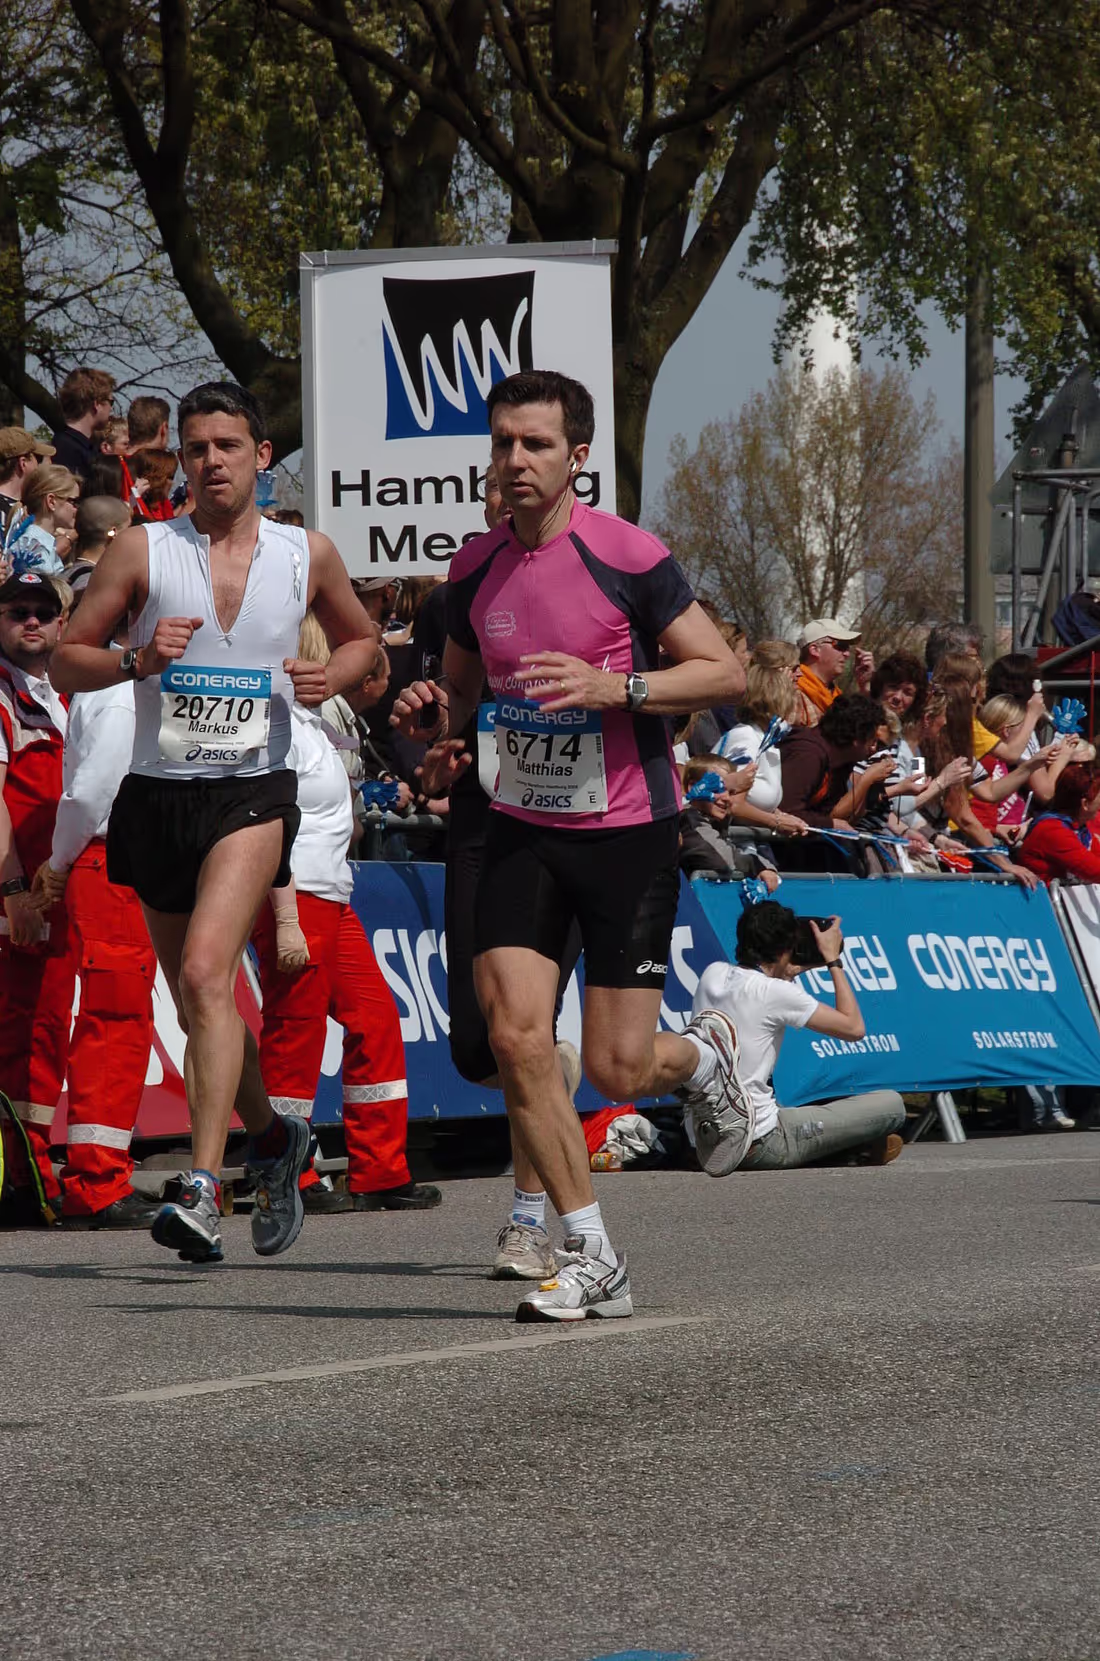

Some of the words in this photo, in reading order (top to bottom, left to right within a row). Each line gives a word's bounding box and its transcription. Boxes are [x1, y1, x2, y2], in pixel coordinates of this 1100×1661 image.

[331, 465, 601, 508] Hambg
[170, 672, 261, 690] CONERGY
[172, 694, 254, 722] 20710
[501, 704, 587, 725] CONERGY
[188, 720, 239, 735] Markus
[505, 729, 582, 762] 6714
[516, 759, 573, 777] Matthias
[907, 932, 1057, 993] CONERGY
[811, 1034, 901, 1058] SOLARSTROM
[972, 1030, 1058, 1049] SOLARSTROM
